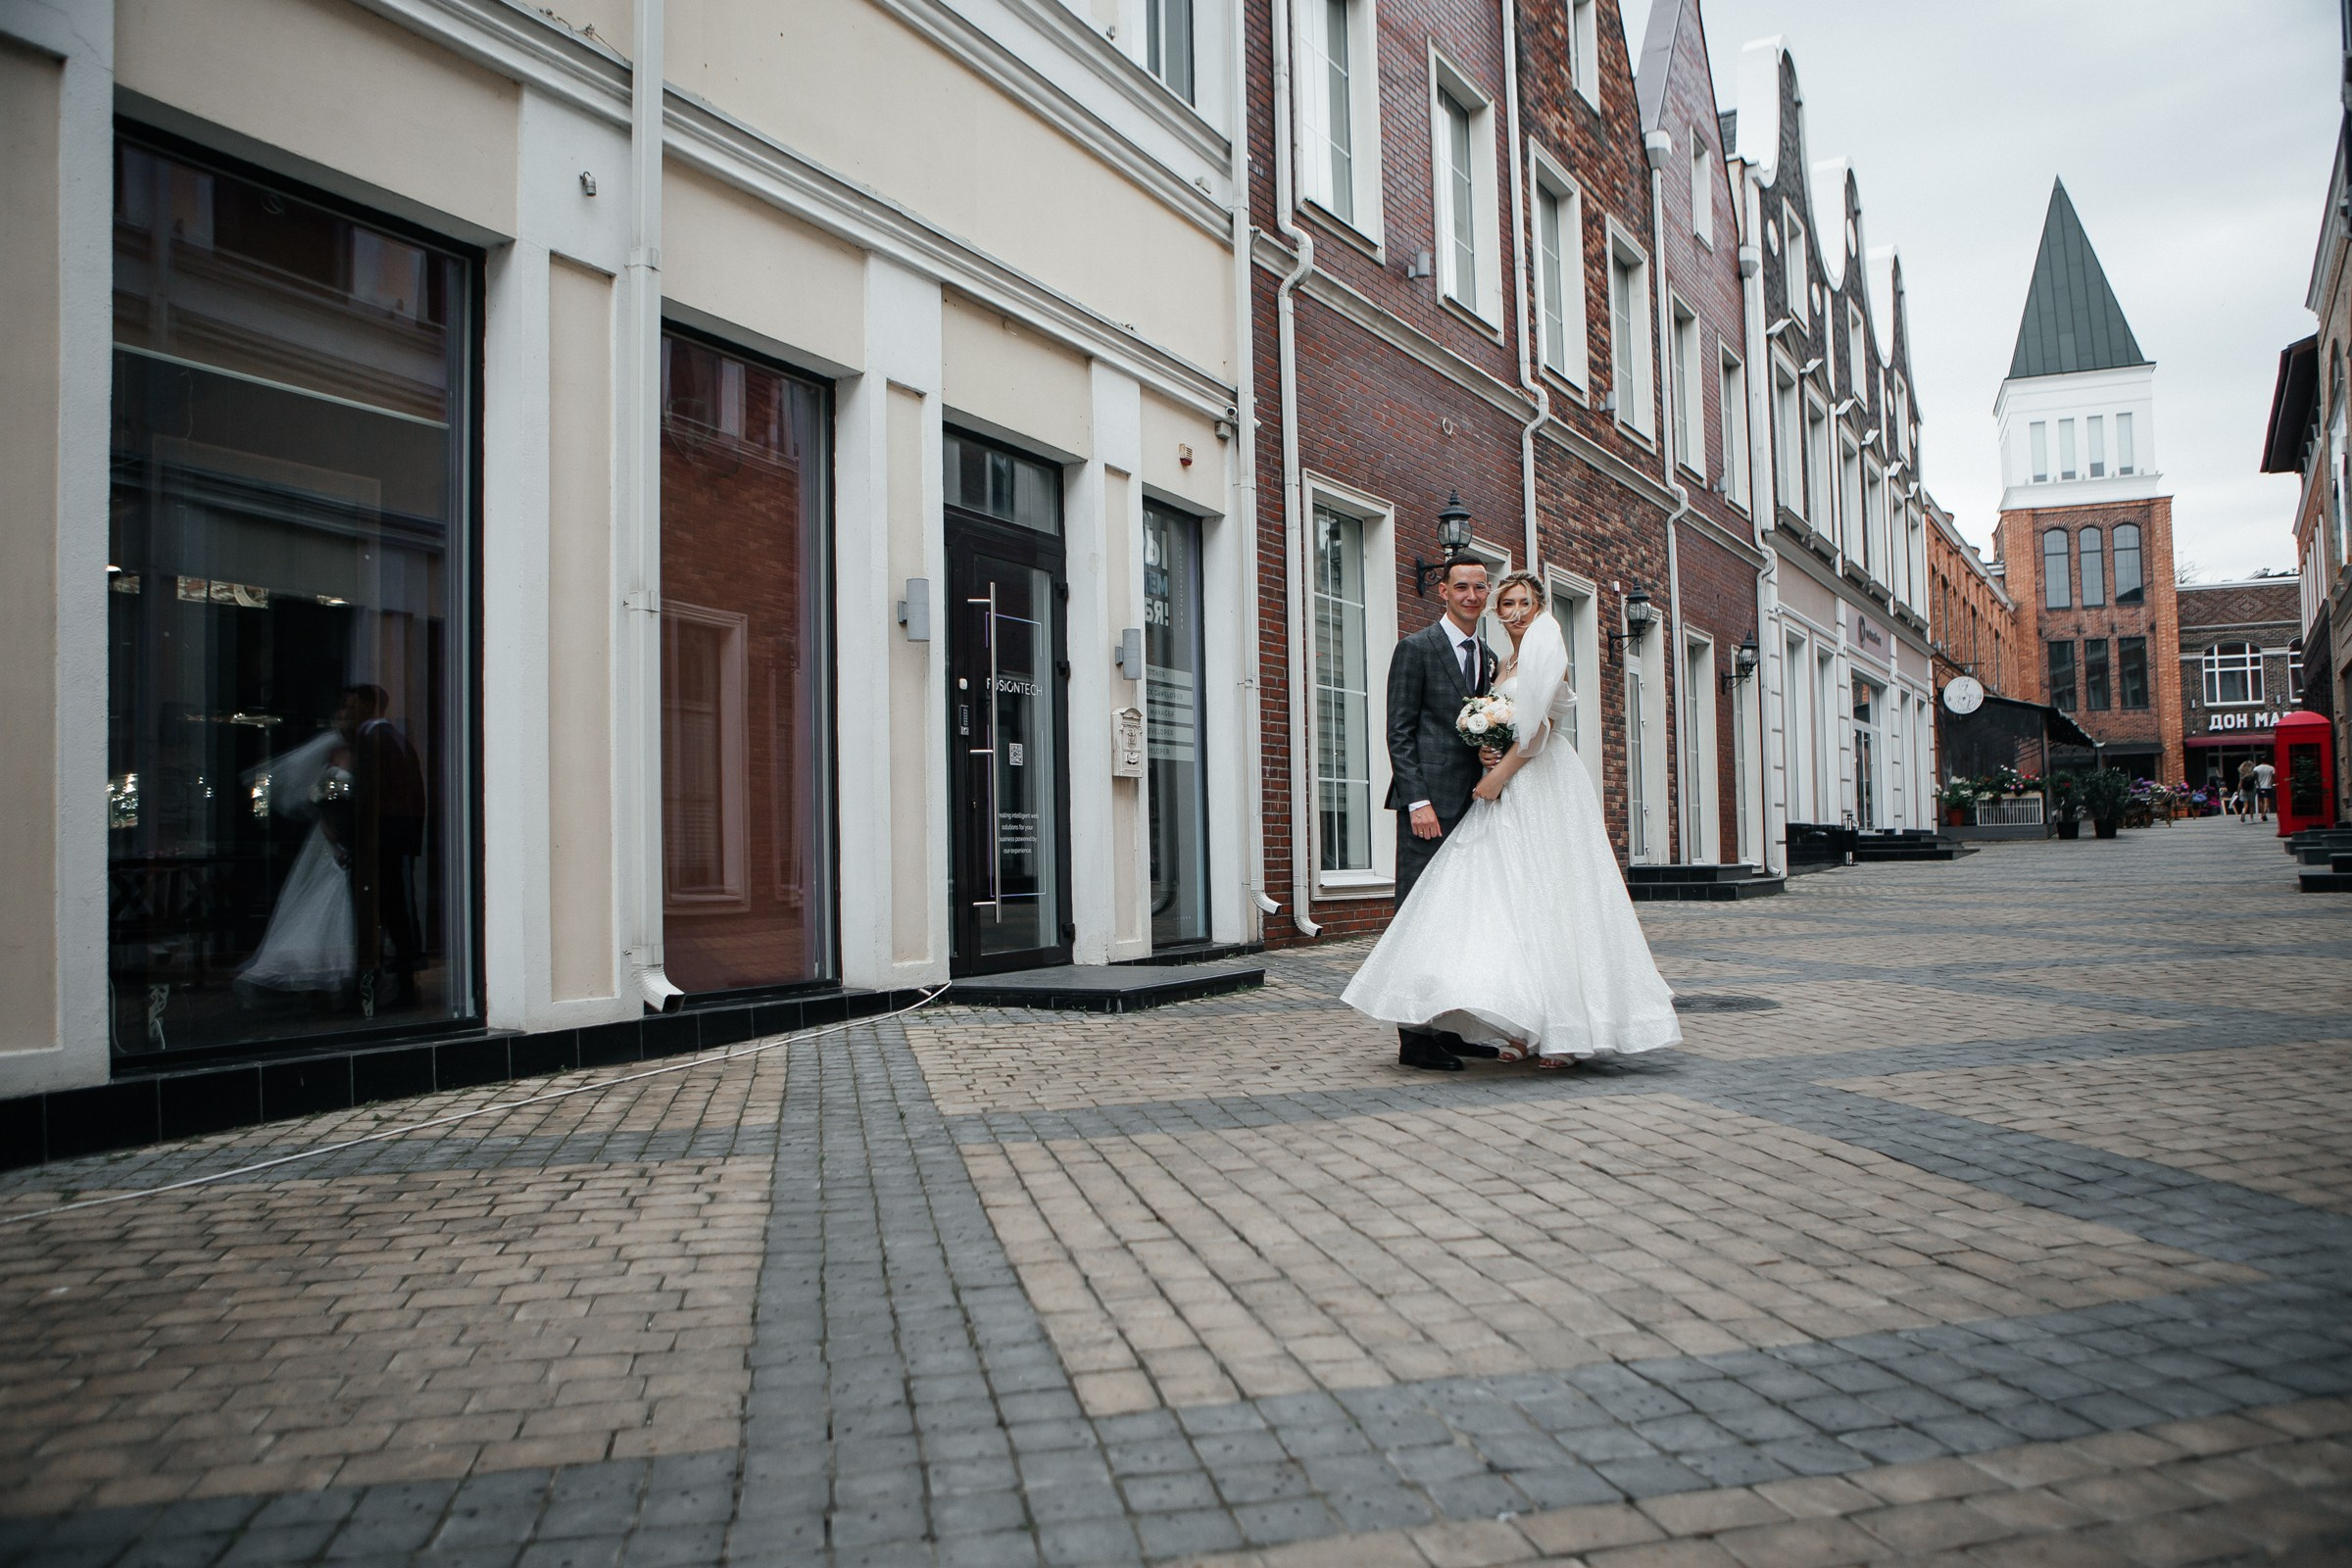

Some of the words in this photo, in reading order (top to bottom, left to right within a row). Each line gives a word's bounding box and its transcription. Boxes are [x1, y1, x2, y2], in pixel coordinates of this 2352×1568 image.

[1144, 525, 1168, 570] Ы
[1145, 570, 1169, 598] ЕМ
[1145, 596, 1169, 627] БЯ!
[1150, 708, 1175, 717] MANAGER
[2208, 712, 2248, 731] ДОН
[2254, 710, 2293, 728] МА
[1148, 727, 1174, 736] EVELOPER
